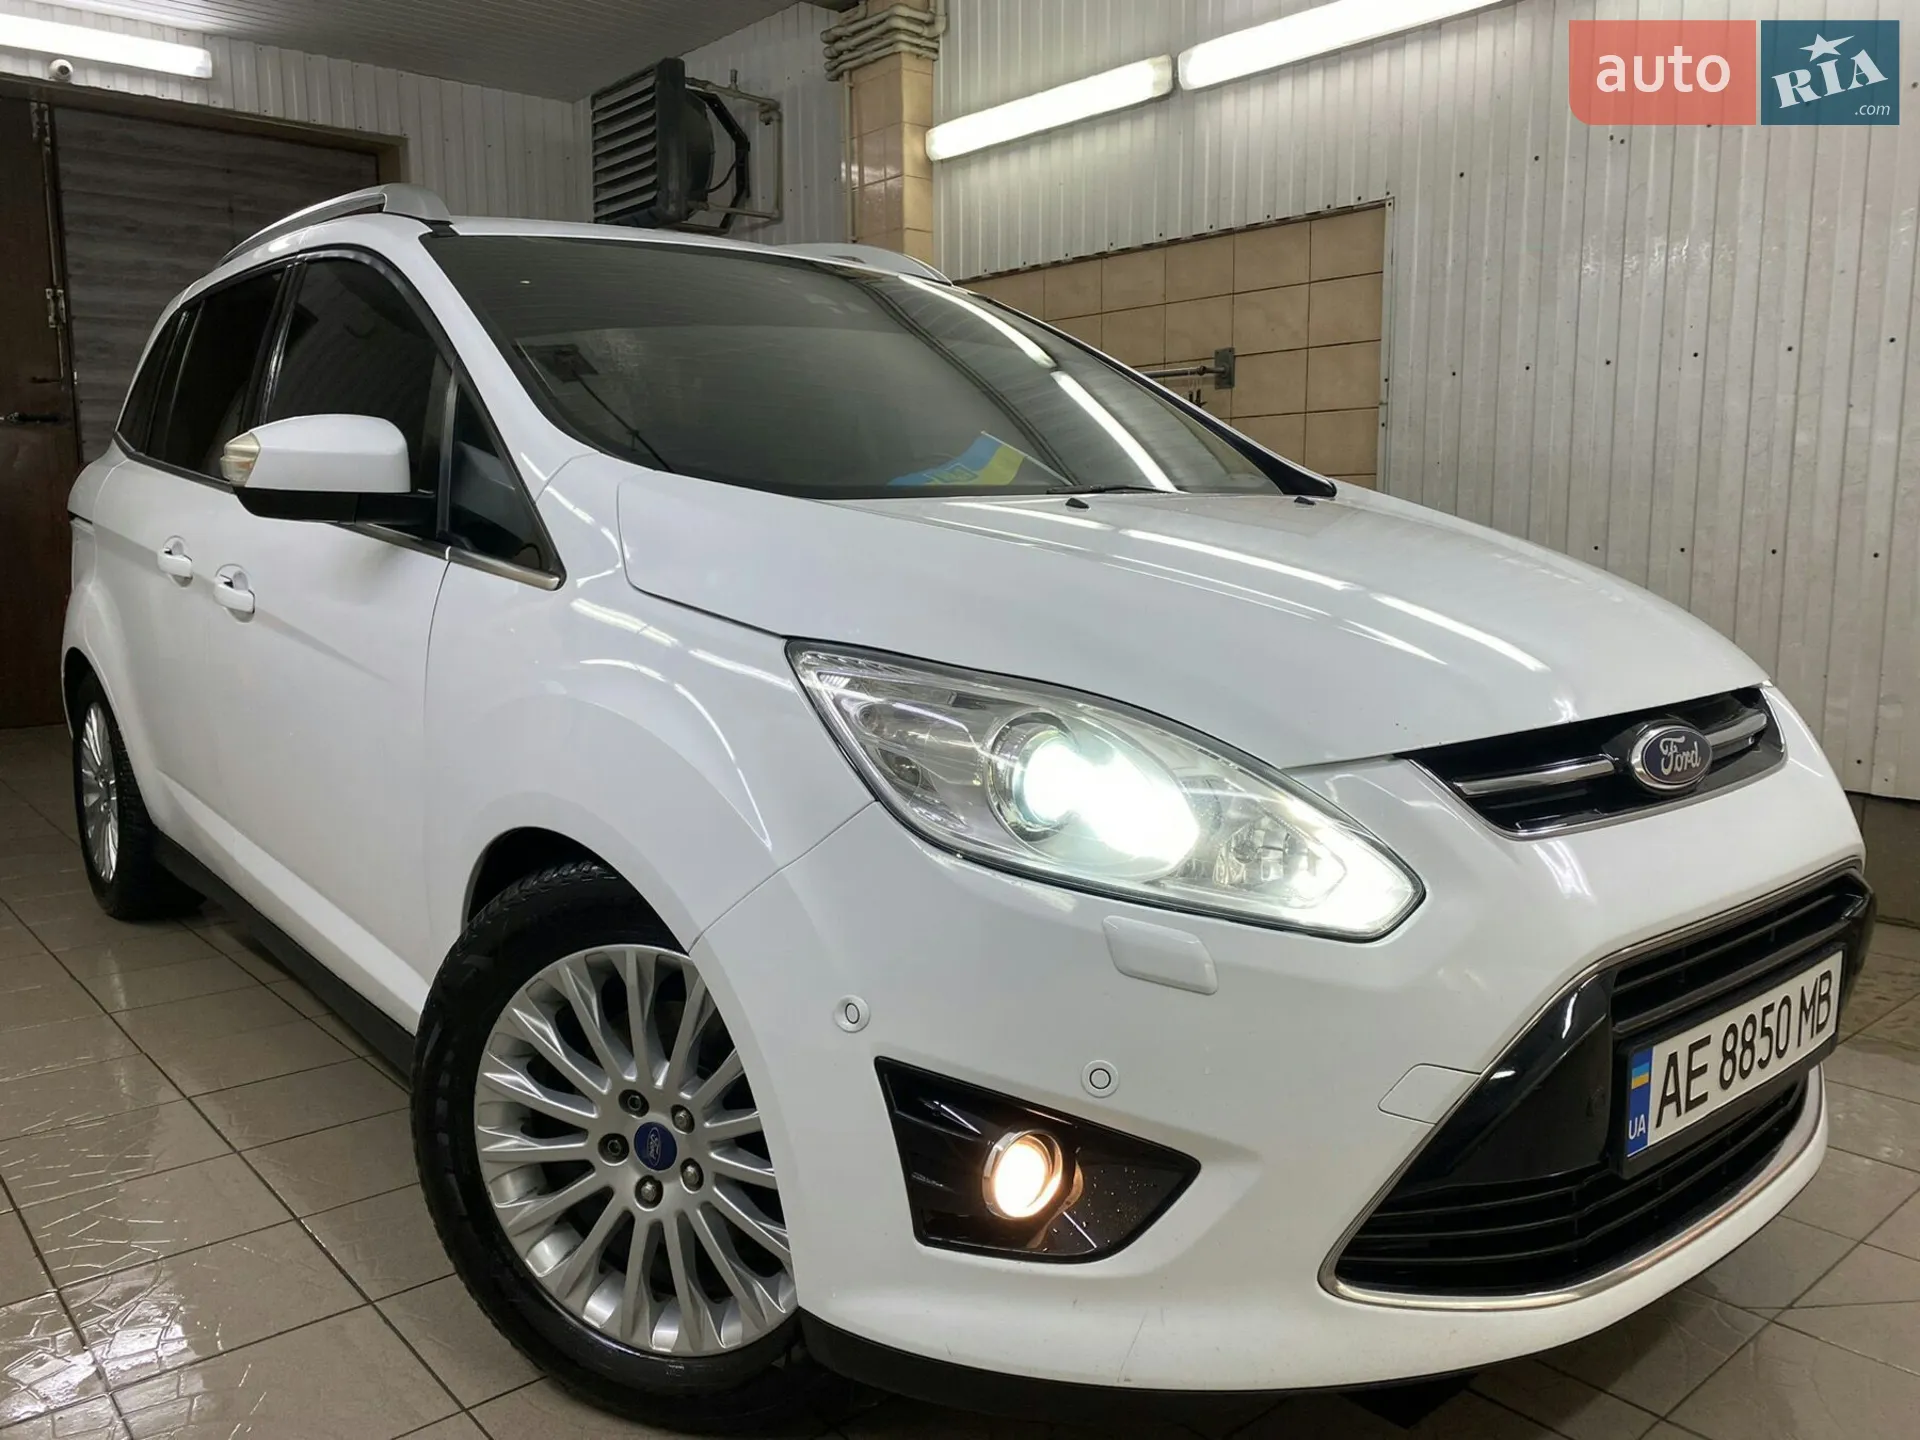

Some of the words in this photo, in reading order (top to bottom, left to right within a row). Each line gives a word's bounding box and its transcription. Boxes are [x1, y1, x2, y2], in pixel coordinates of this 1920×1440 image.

[1659, 735, 1701, 776] Ford
[1655, 1034, 1712, 1129] AE
[1719, 995, 1792, 1090] 8850
[1797, 969, 1833, 1048] MB
[1628, 1113, 1646, 1140] UA
